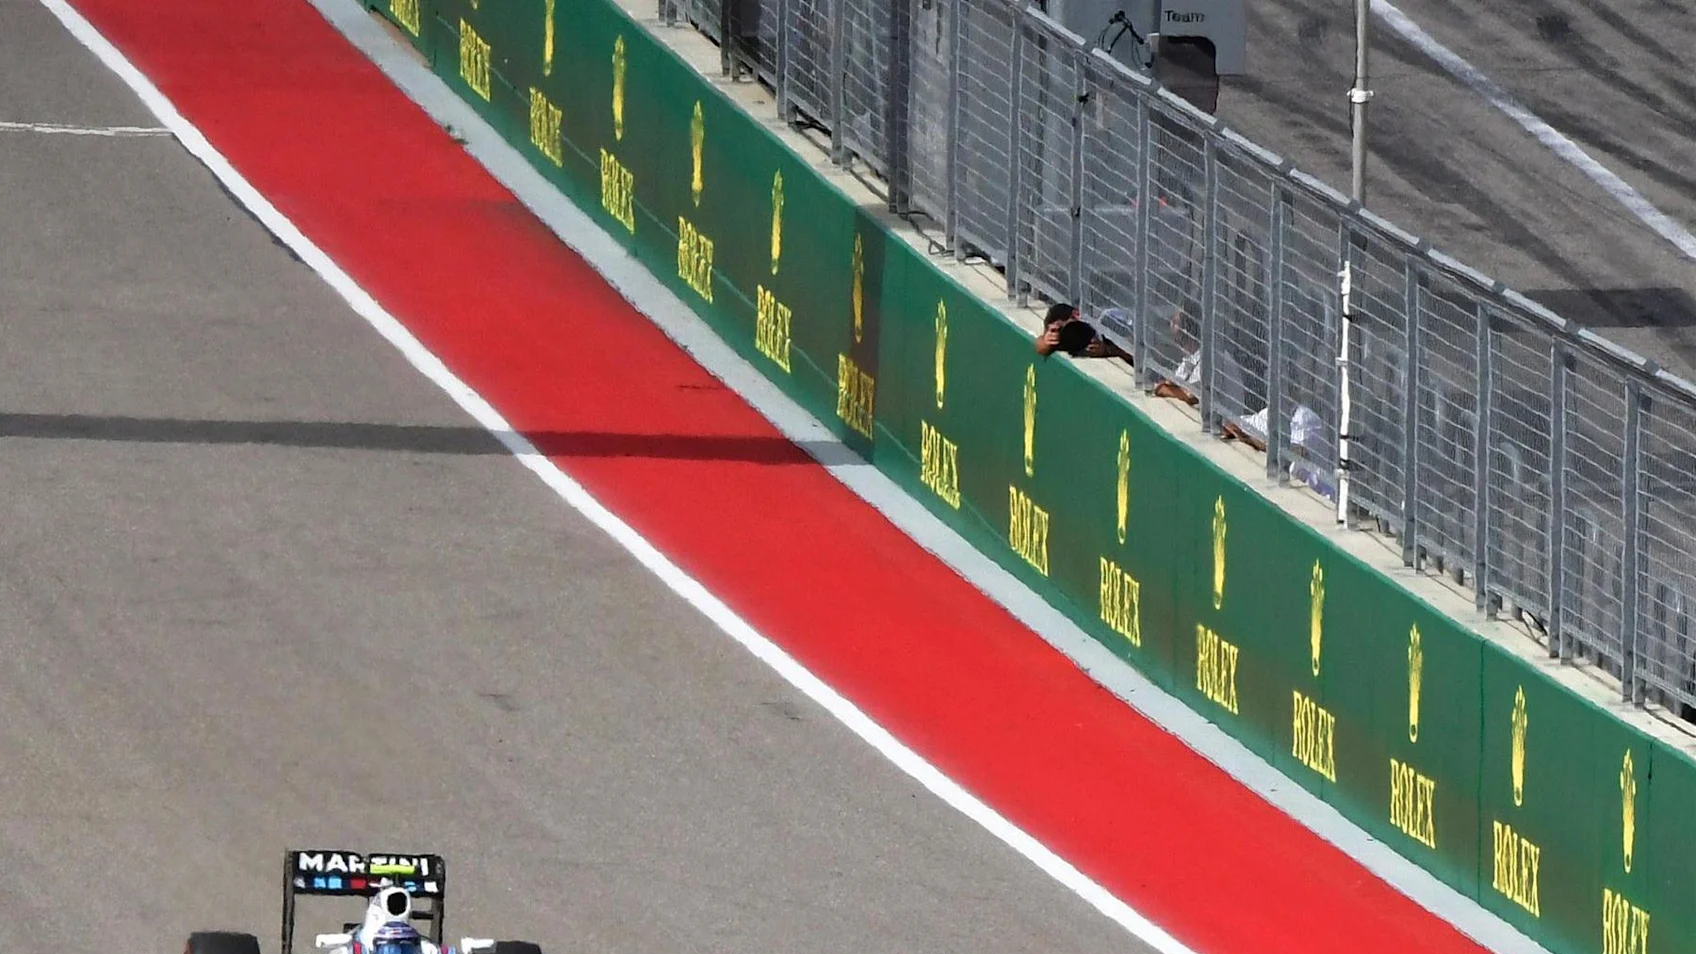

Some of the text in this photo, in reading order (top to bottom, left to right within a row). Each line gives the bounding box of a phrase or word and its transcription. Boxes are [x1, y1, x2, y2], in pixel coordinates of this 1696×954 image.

[1164, 10, 1205, 22] Team
[920, 419, 961, 511] ROLEX
[1008, 485, 1050, 578] ROLEX
[1099, 556, 1142, 648] ROLEX
[1196, 623, 1240, 715] ROLEX
[1292, 690, 1337, 783] ROLEX
[1389, 758, 1437, 850] ROLEX
[1492, 820, 1541, 919] ROLEX
